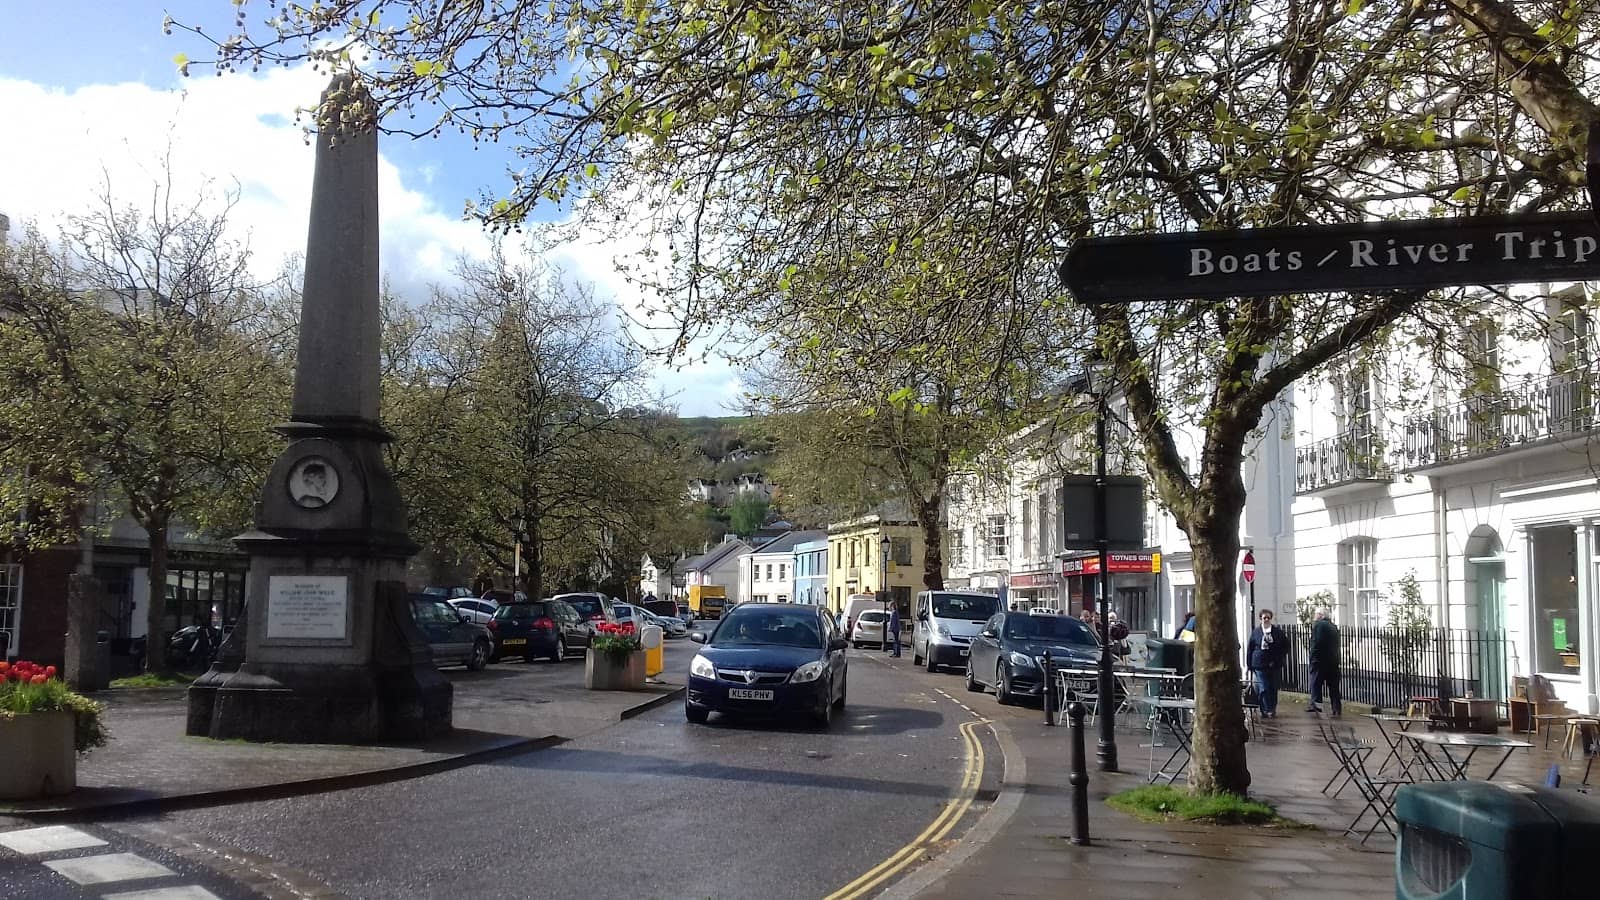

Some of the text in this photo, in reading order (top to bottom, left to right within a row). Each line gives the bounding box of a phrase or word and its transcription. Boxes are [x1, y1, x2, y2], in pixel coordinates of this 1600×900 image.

[1188, 248, 1303, 277] Boats
[1349, 239, 1474, 268] River
[1495, 230, 1597, 263] Trip
